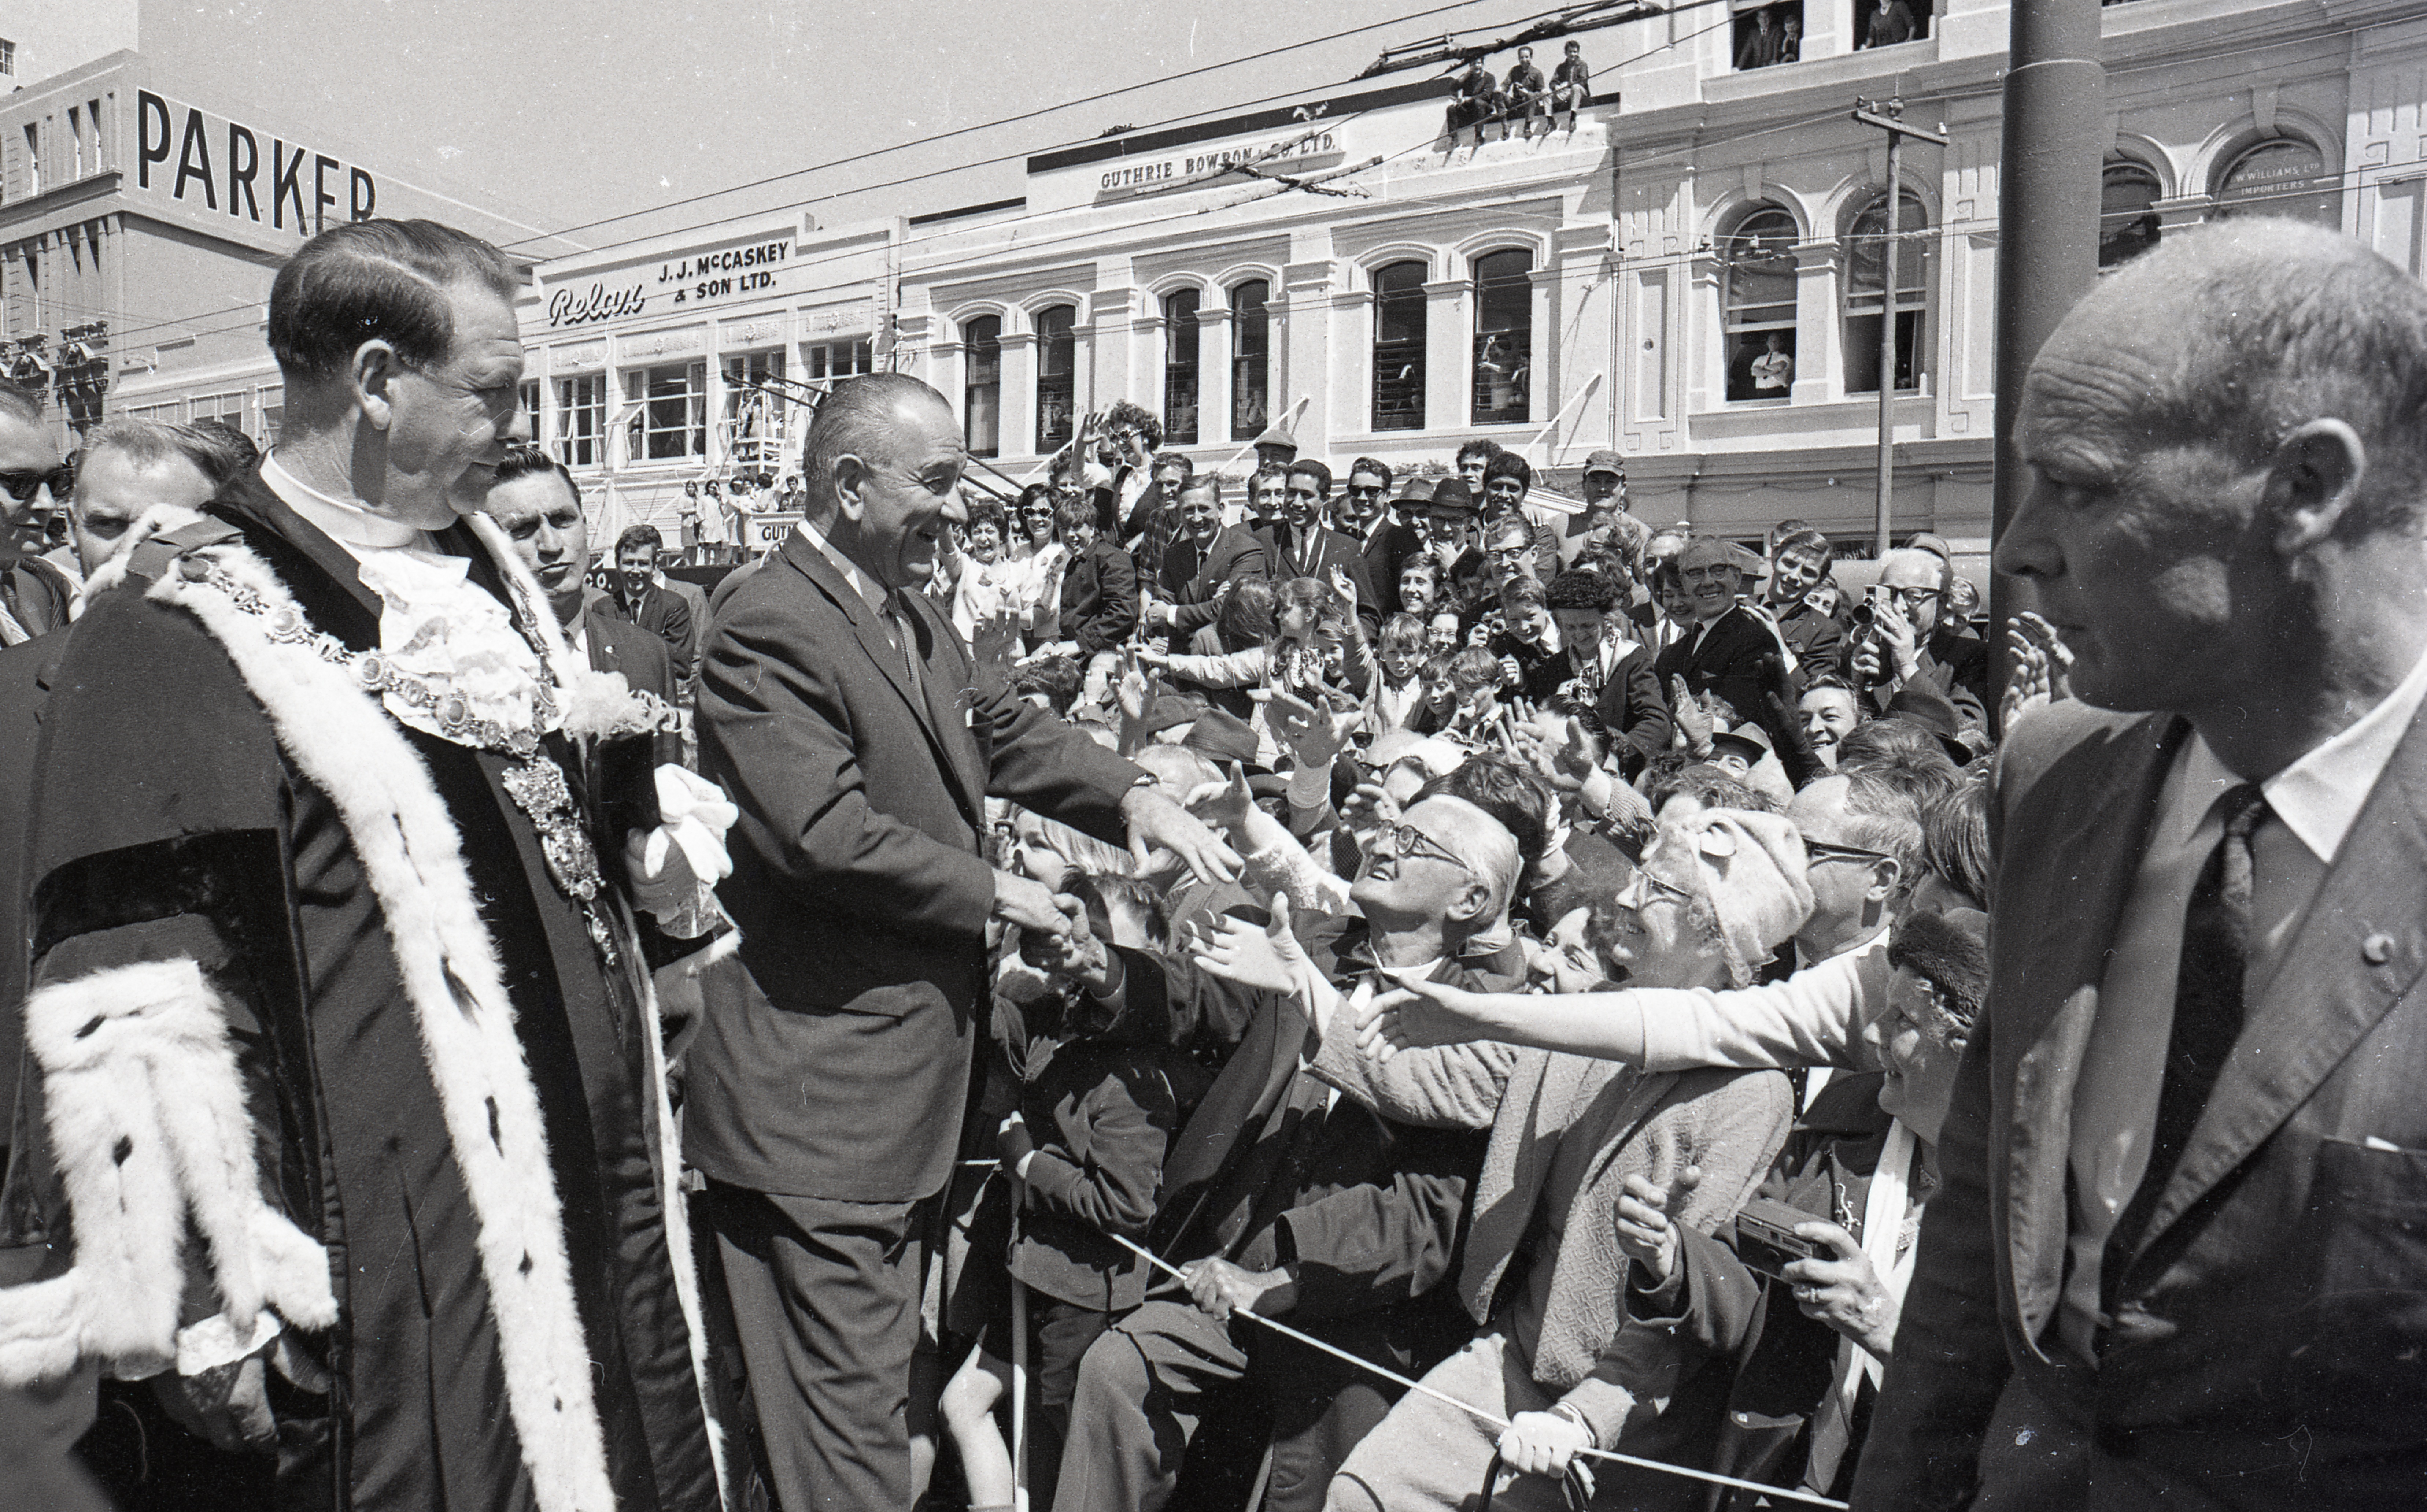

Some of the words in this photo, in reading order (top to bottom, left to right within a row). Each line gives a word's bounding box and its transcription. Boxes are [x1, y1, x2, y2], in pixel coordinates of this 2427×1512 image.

[138, 89, 376, 237] PARKER
[1101, 161, 1172, 189] GUTHRIE
[1185, 147, 1252, 174] BOWRON
[1301, 133, 1336, 153] LTD.
[2241, 180, 2303, 196] IMPORTERS
[548, 280, 646, 327] Relax
[675, 289, 686, 302] &
[697, 277, 731, 299] SON
[740, 271, 776, 291] LTD.
